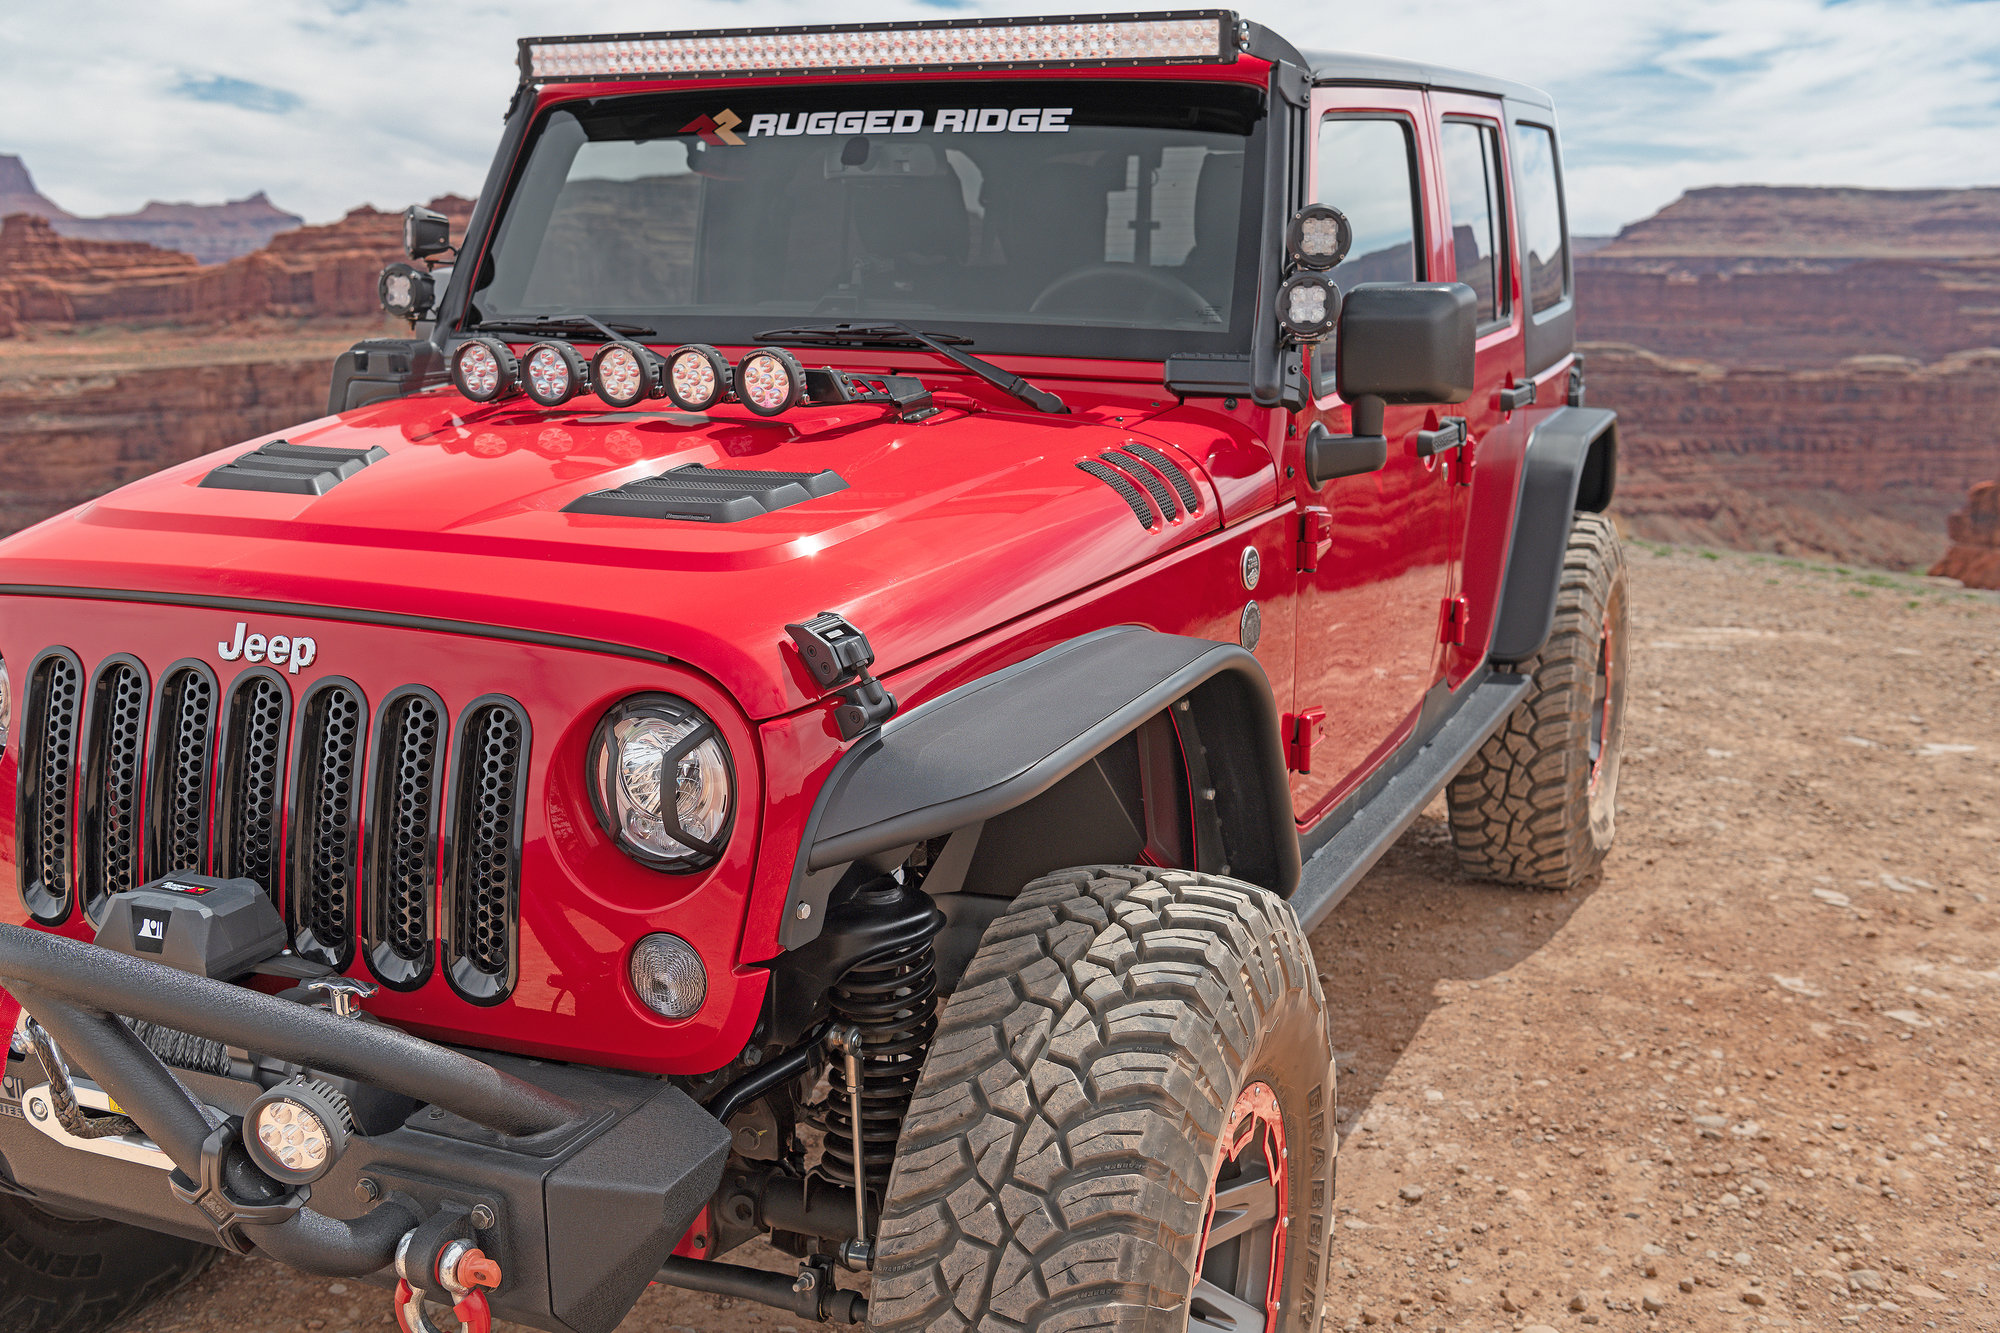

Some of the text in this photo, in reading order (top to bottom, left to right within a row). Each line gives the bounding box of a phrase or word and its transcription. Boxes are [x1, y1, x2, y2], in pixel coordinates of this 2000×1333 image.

[748, 108, 1073, 137] RUGGED RIDGE
[218, 622, 317, 674] Jeep
[1301, 1082, 1325, 1326] GRABBER
